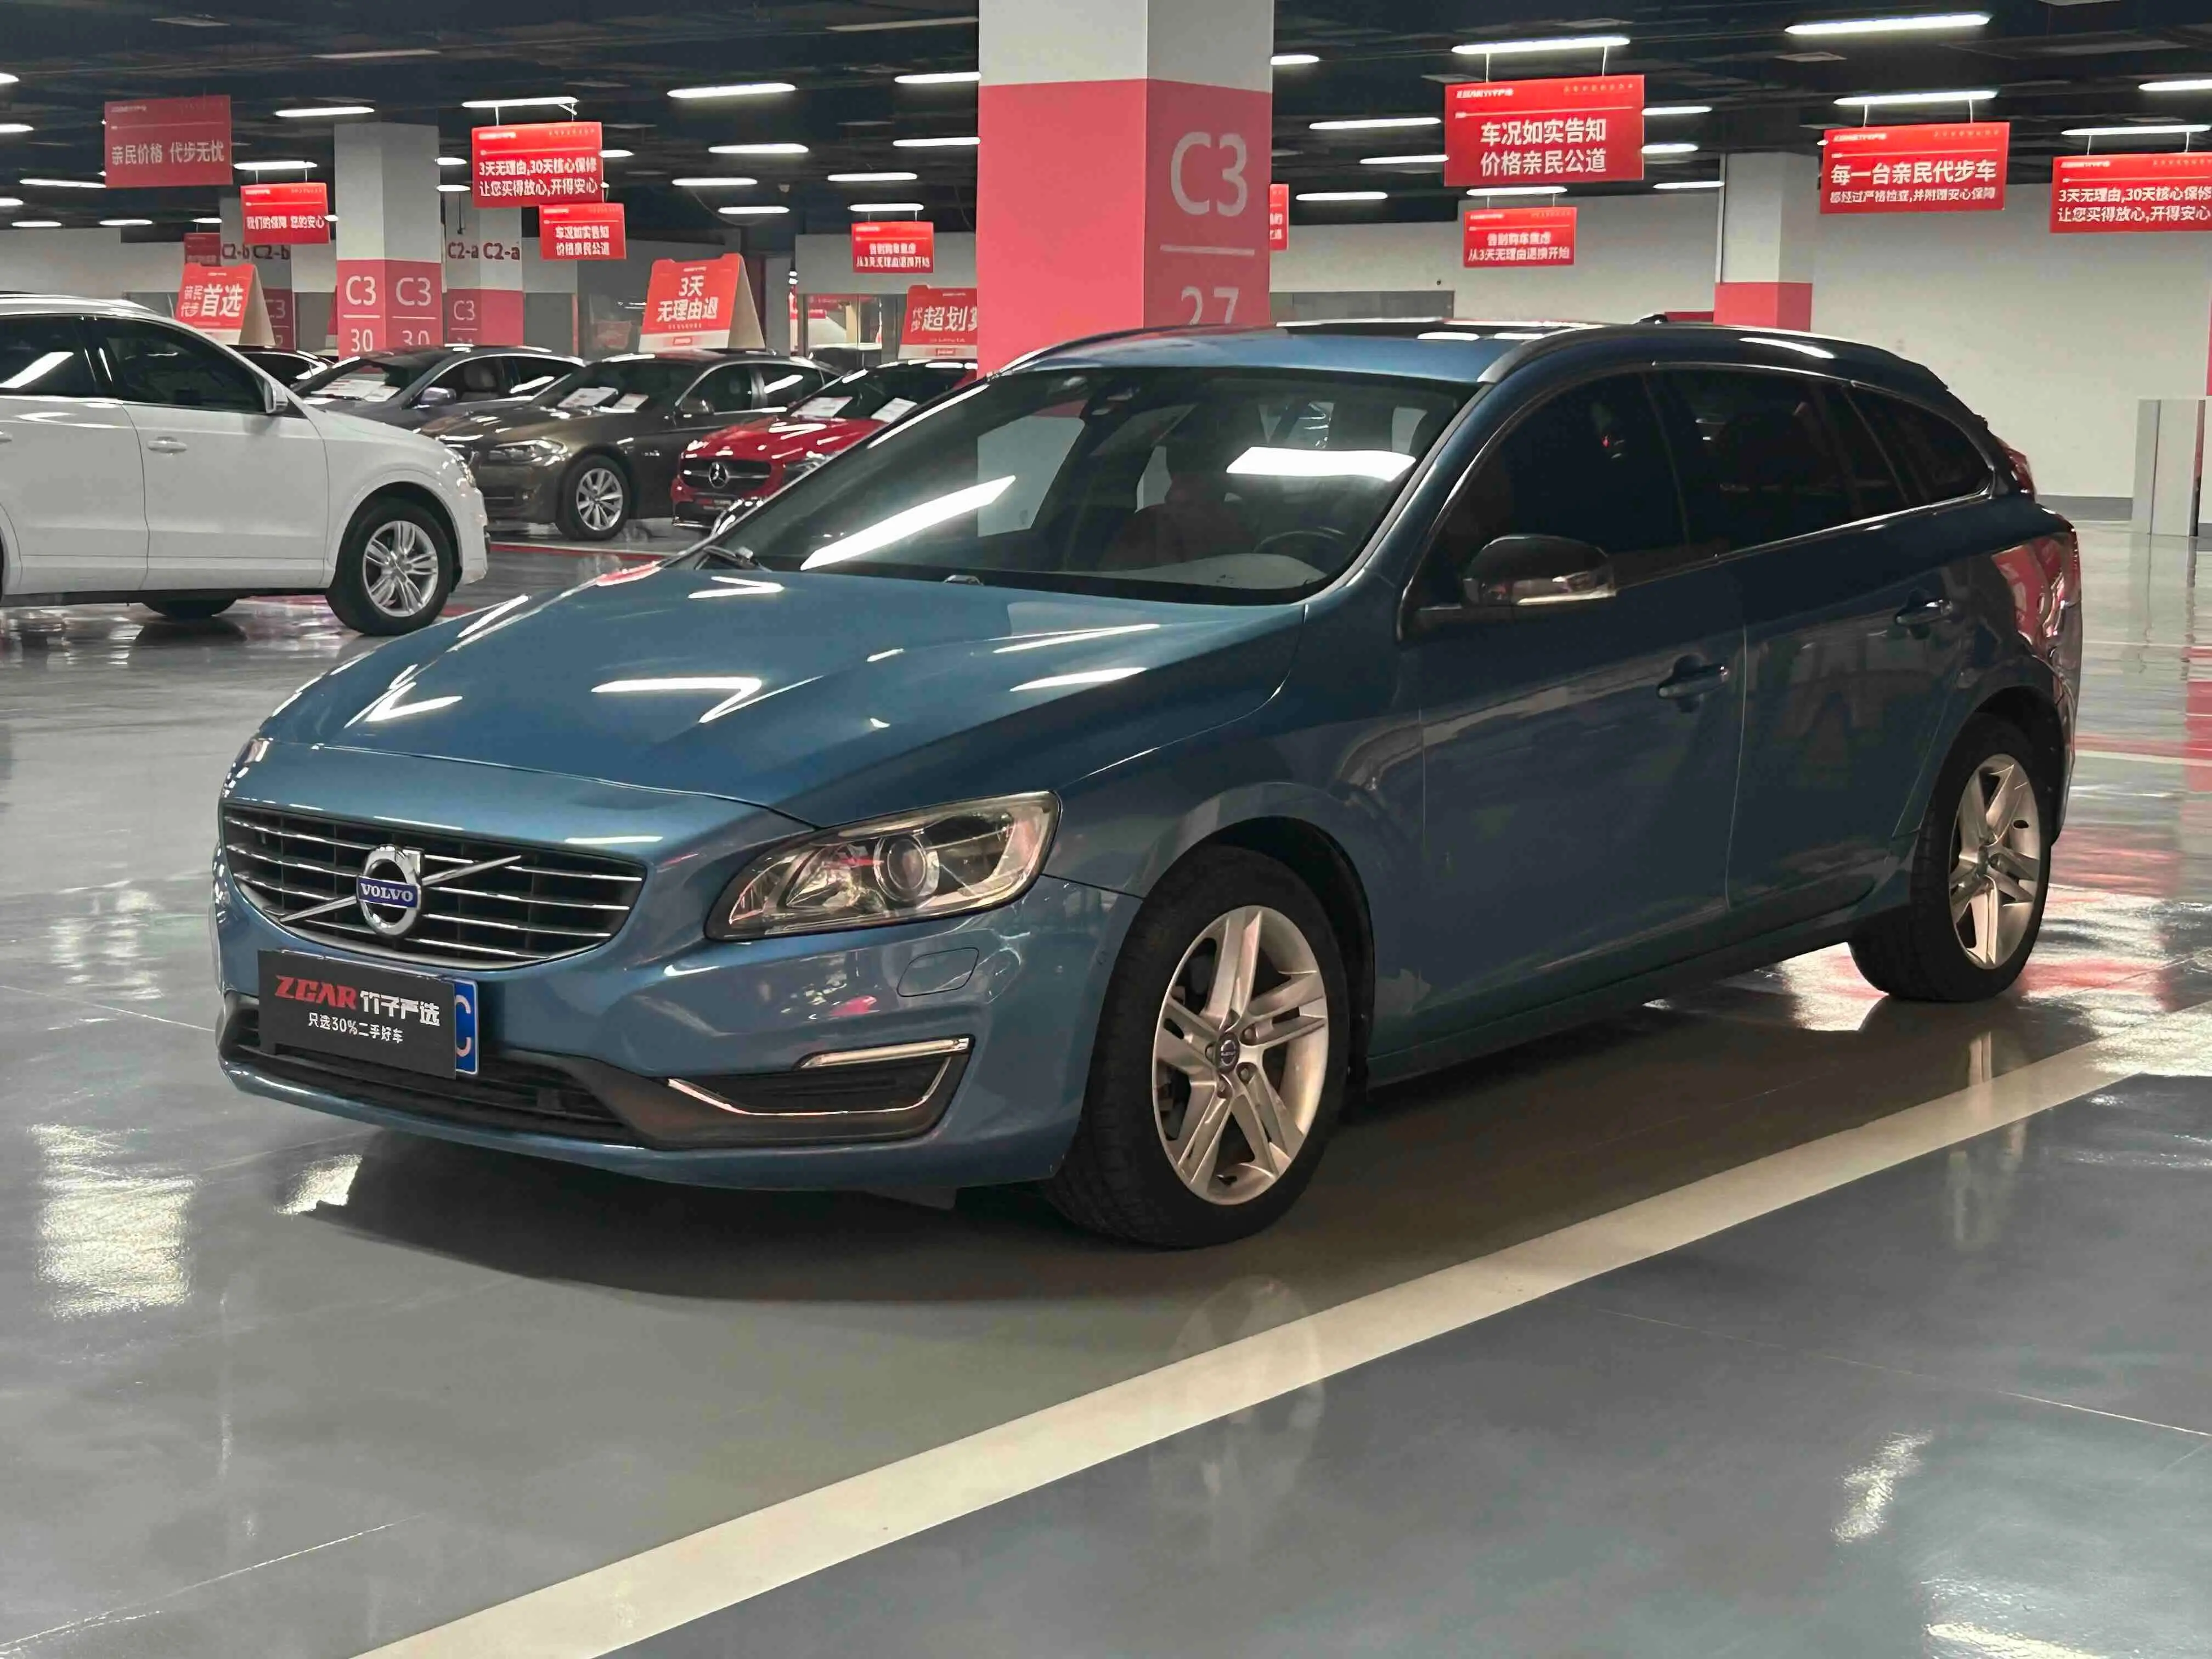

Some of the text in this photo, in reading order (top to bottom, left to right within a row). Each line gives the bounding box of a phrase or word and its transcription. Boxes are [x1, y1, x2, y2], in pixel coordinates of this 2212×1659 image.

[1481, 117, 1607, 146] 车况如实告知
[111, 139, 224, 165] 亲民价格 代步无忧
[1481, 148, 1607, 177] 价格亲民公道
[1170, 131, 1248, 217] C3
[1830, 159, 1997, 185] 每一台亲民代步车
[2058, 187, 2212, 203] 3天无理由,30天核心保修
[2058, 205, 2211, 223] 让您买得放心,开得安心
[448, 241, 478, 259] C2-a
[483, 242, 520, 260] C2-a
[345, 275, 376, 306] C3
[396, 277, 432, 306] C3
[679, 275, 704, 296] 3天
[201, 284, 244, 317] 首选
[453, 300, 475, 321] C3
[657, 297, 718, 321] 无理由退
[1181, 286, 1239, 325] 27
[351, 329, 374, 353] 30
[360, 883, 413, 902] VOLVO
[274, 975, 357, 1011] ZCAR
[360, 990, 441, 1027] 竹子严选
[308, 1012, 404, 1044] 只选30%二手好车
